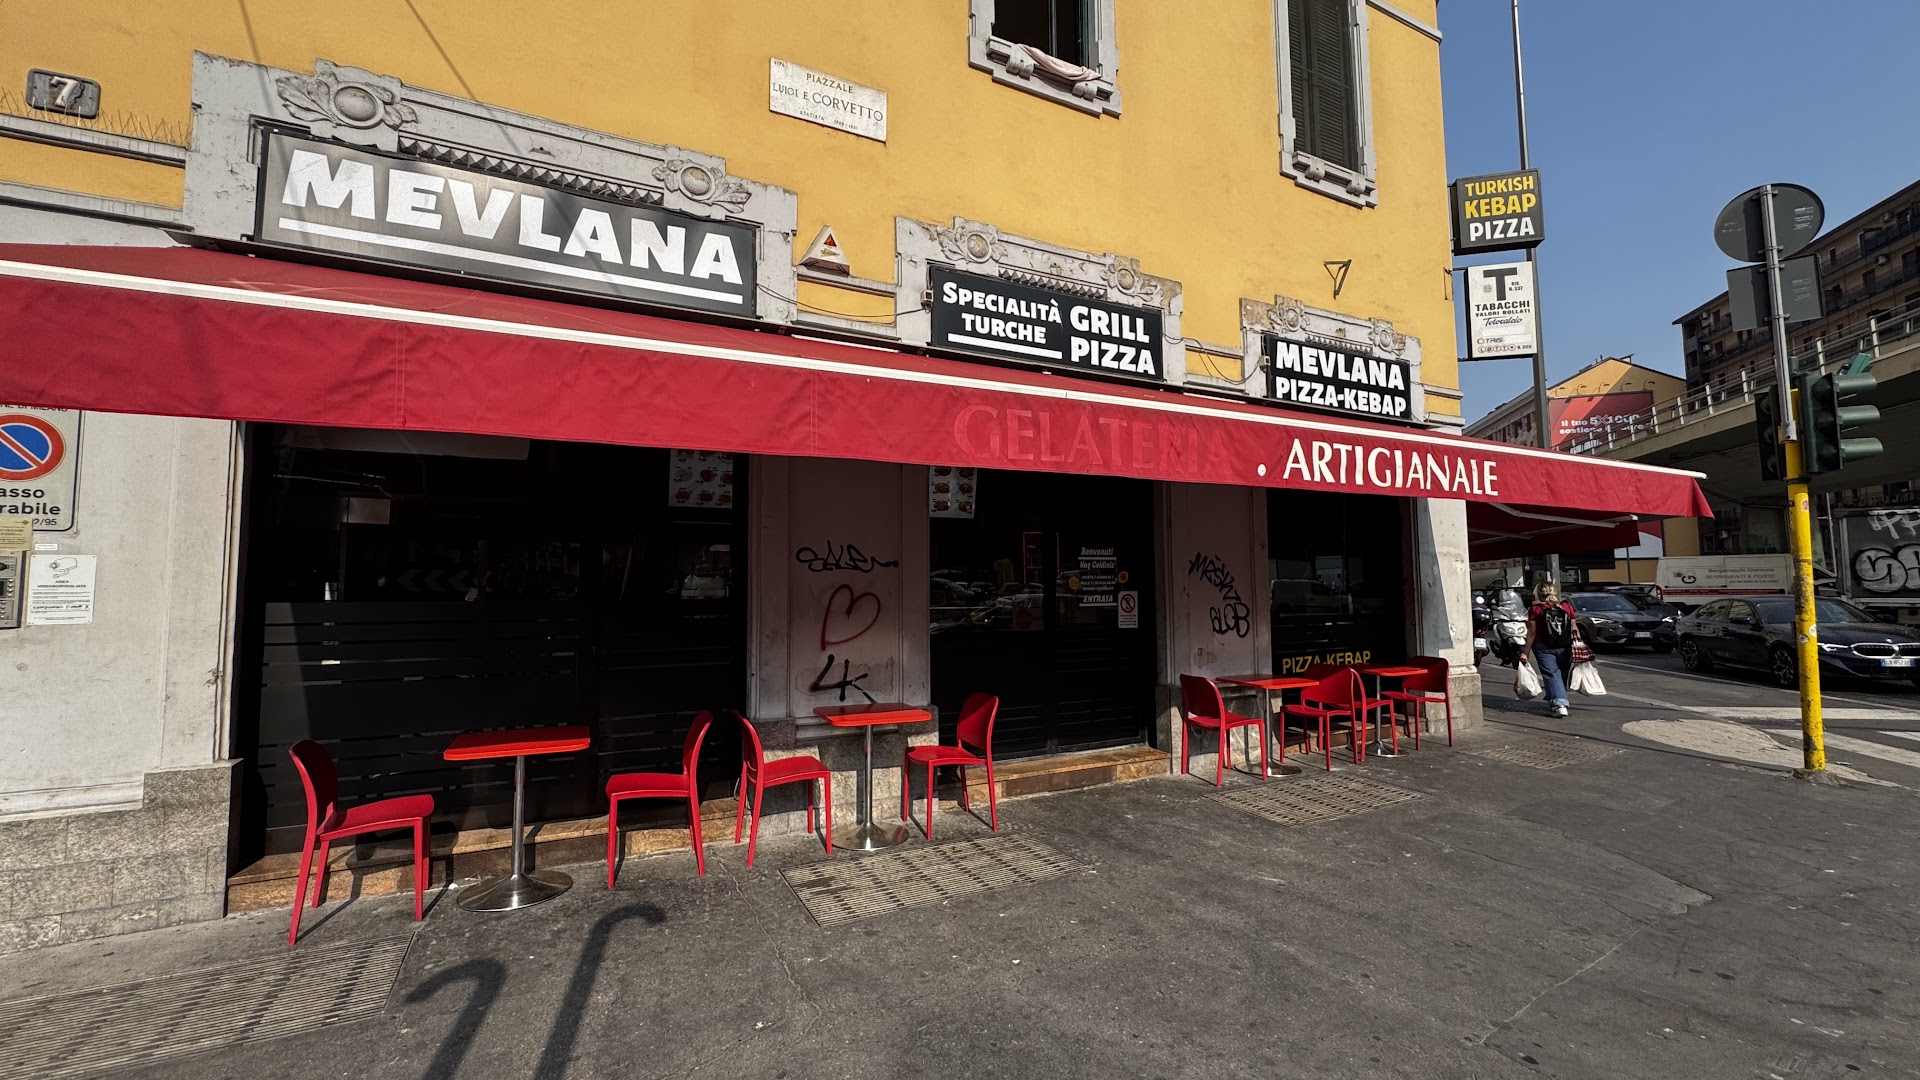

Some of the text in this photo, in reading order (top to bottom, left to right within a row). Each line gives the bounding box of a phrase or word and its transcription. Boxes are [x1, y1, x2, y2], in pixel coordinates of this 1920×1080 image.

[48, 76, 80, 109] 7
[806, 73, 854, 94] PIAZZALE
[772, 82, 799, 98] LUIGI
[812, 92, 883, 122] CORVETTO
[1465, 175, 1534, 197] TURKISH
[281, 149, 743, 285] MEVLANA
[1465, 193, 1536, 219] KEBAP
[1469, 217, 1535, 242] PIZZA
[1483, 267, 1517, 301] T
[942, 280, 1149, 343] SPECIALITÀ GRILL
[1475, 300, 1530, 311] TABACCHI
[1483, 316, 1522, 326] Totocalcio
[962, 311, 1155, 375] TURCHE PIZZA
[1276, 342, 1404, 391] MEVLANA
[1276, 377, 1407, 418] PIZZA-KEBAP
[953, 403, 1499, 497] GELATERIA ARTIGIANALE
[1081, 547, 1113, 556] Benvenuti
[1083, 594, 1114, 603] ENTRATA
